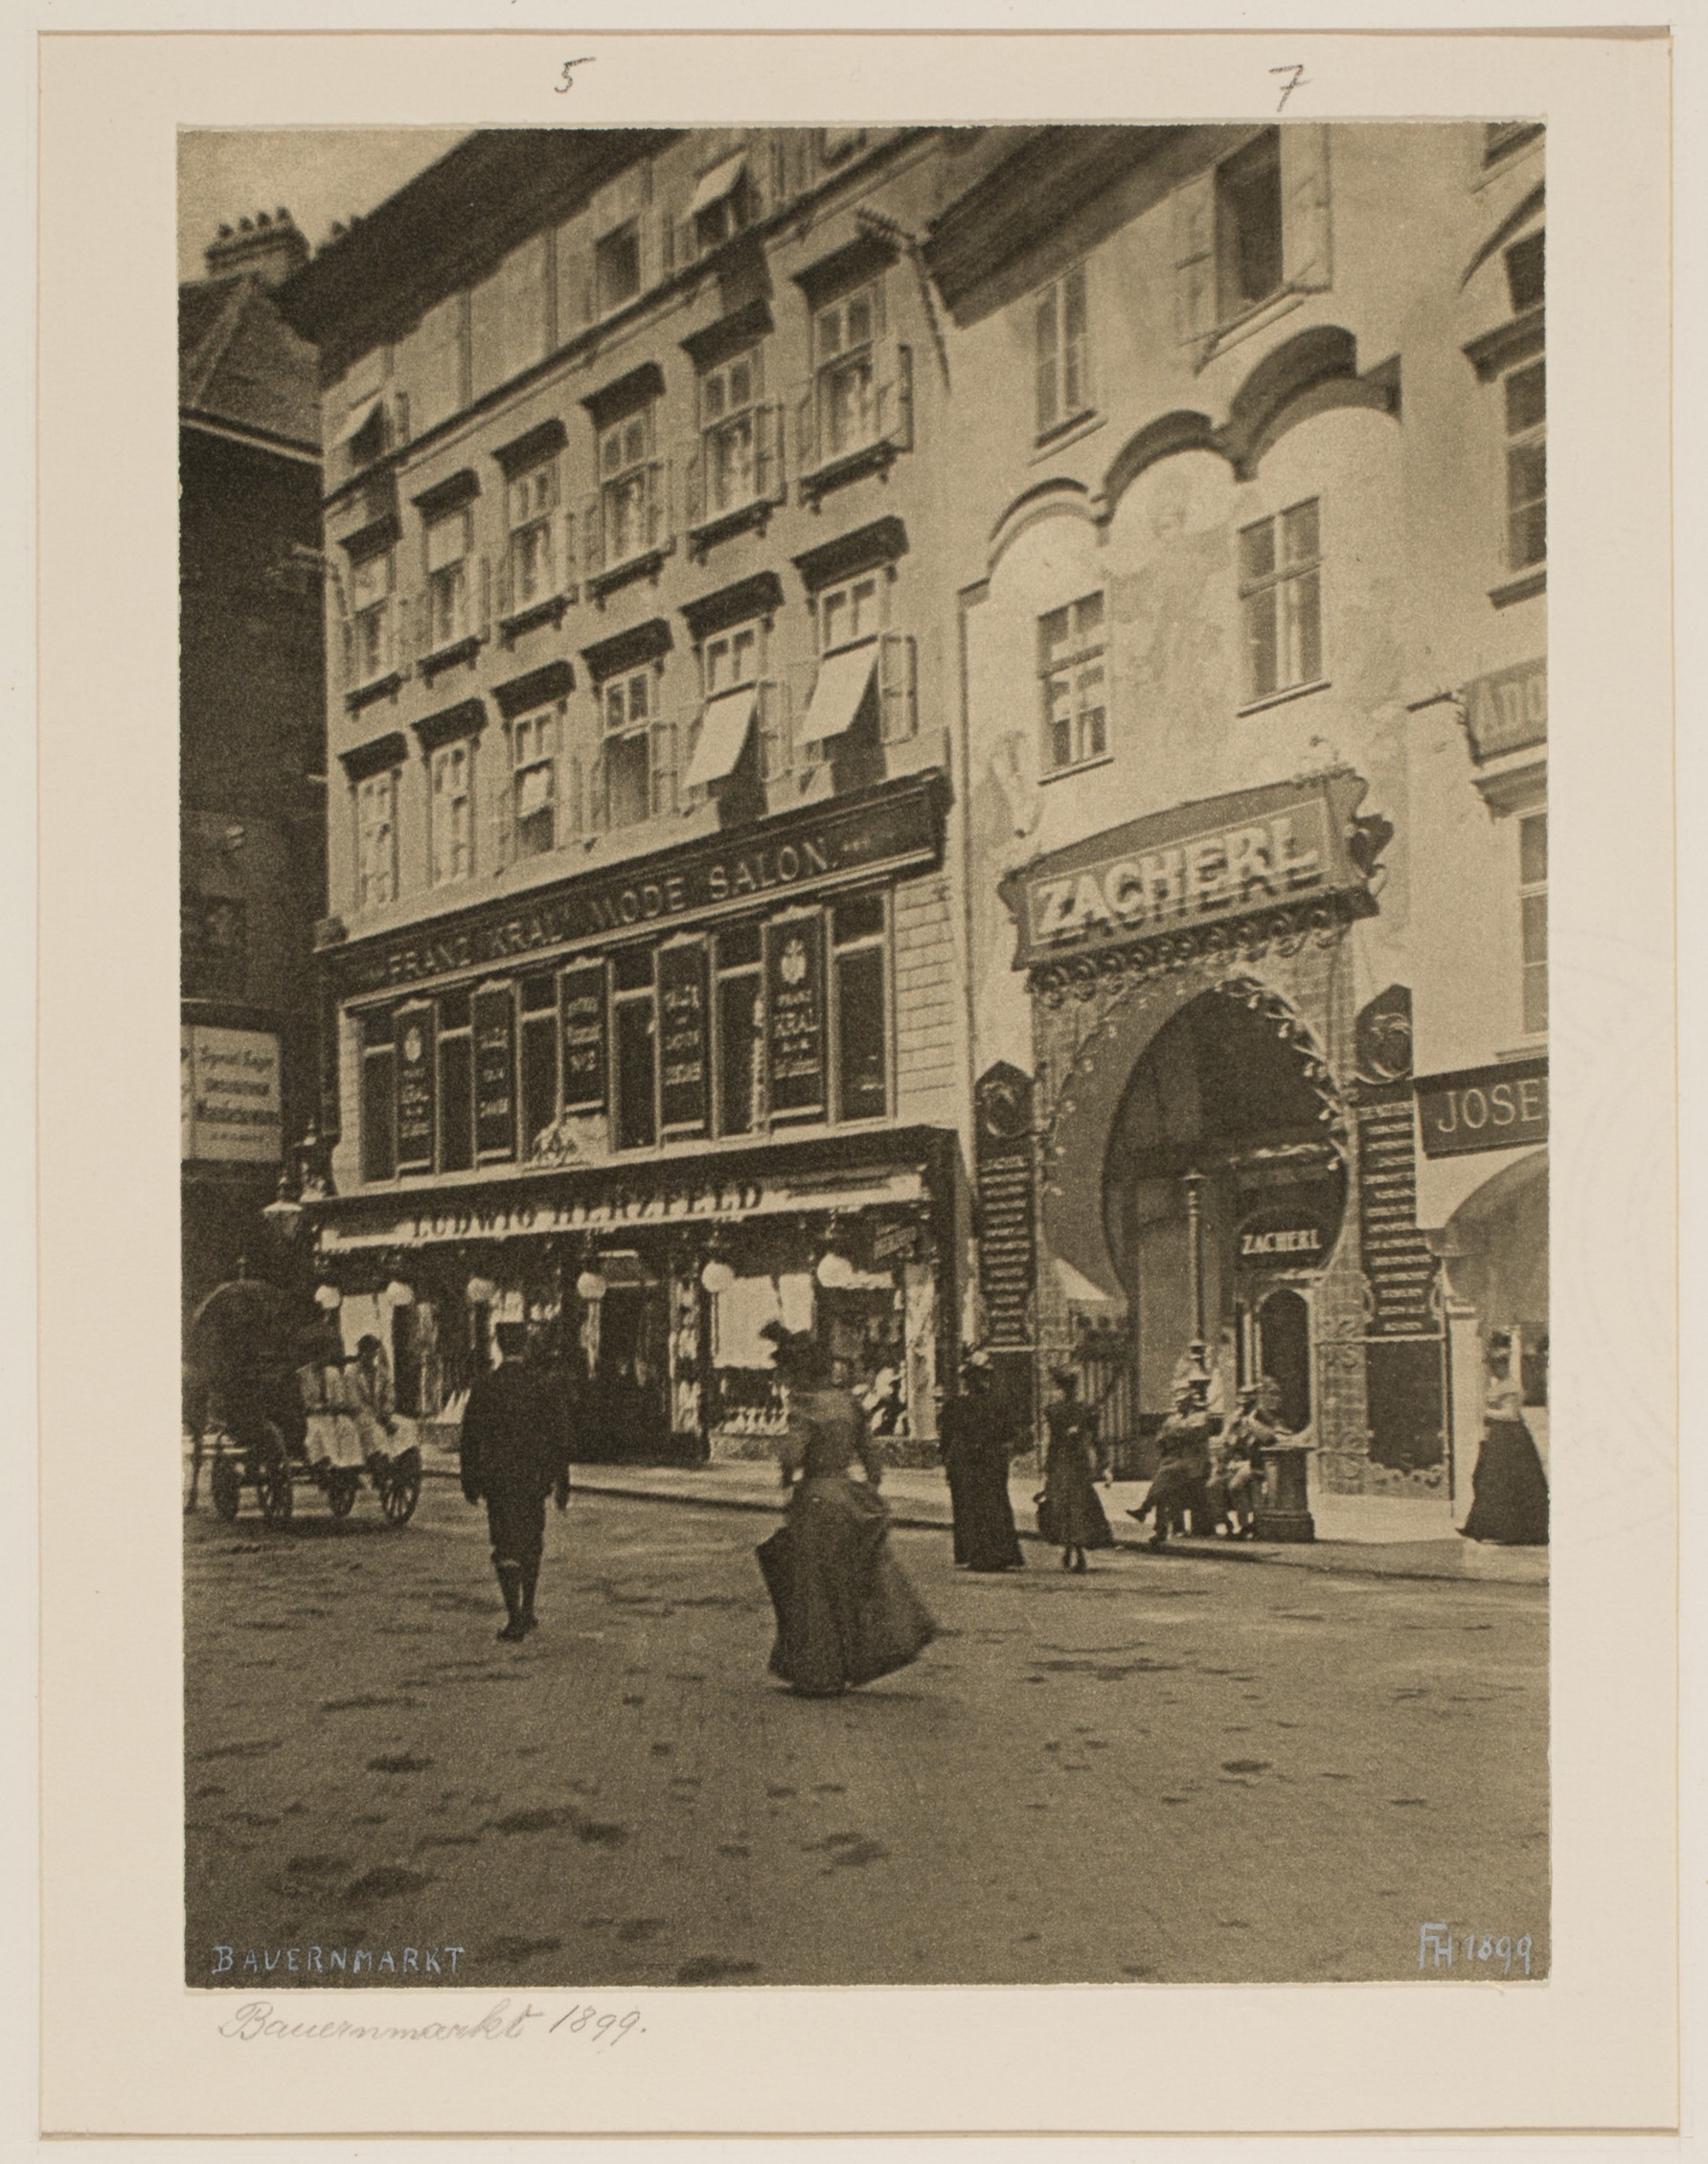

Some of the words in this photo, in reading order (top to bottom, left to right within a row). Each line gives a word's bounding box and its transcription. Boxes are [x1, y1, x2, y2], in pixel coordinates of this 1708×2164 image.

[555, 57, 597, 93] 5
[1267, 63, 1313, 113] 7
[1035, 818, 1320, 938] ZACHERL
[388, 936, 471, 983] FRANZ
[586, 877, 685, 934] MODE
[1438, 1077, 1549, 1132] JOSE
[217, 1997, 543, 2040] Bauernmarkt
[549, 2004, 648, 2047] 1899.
